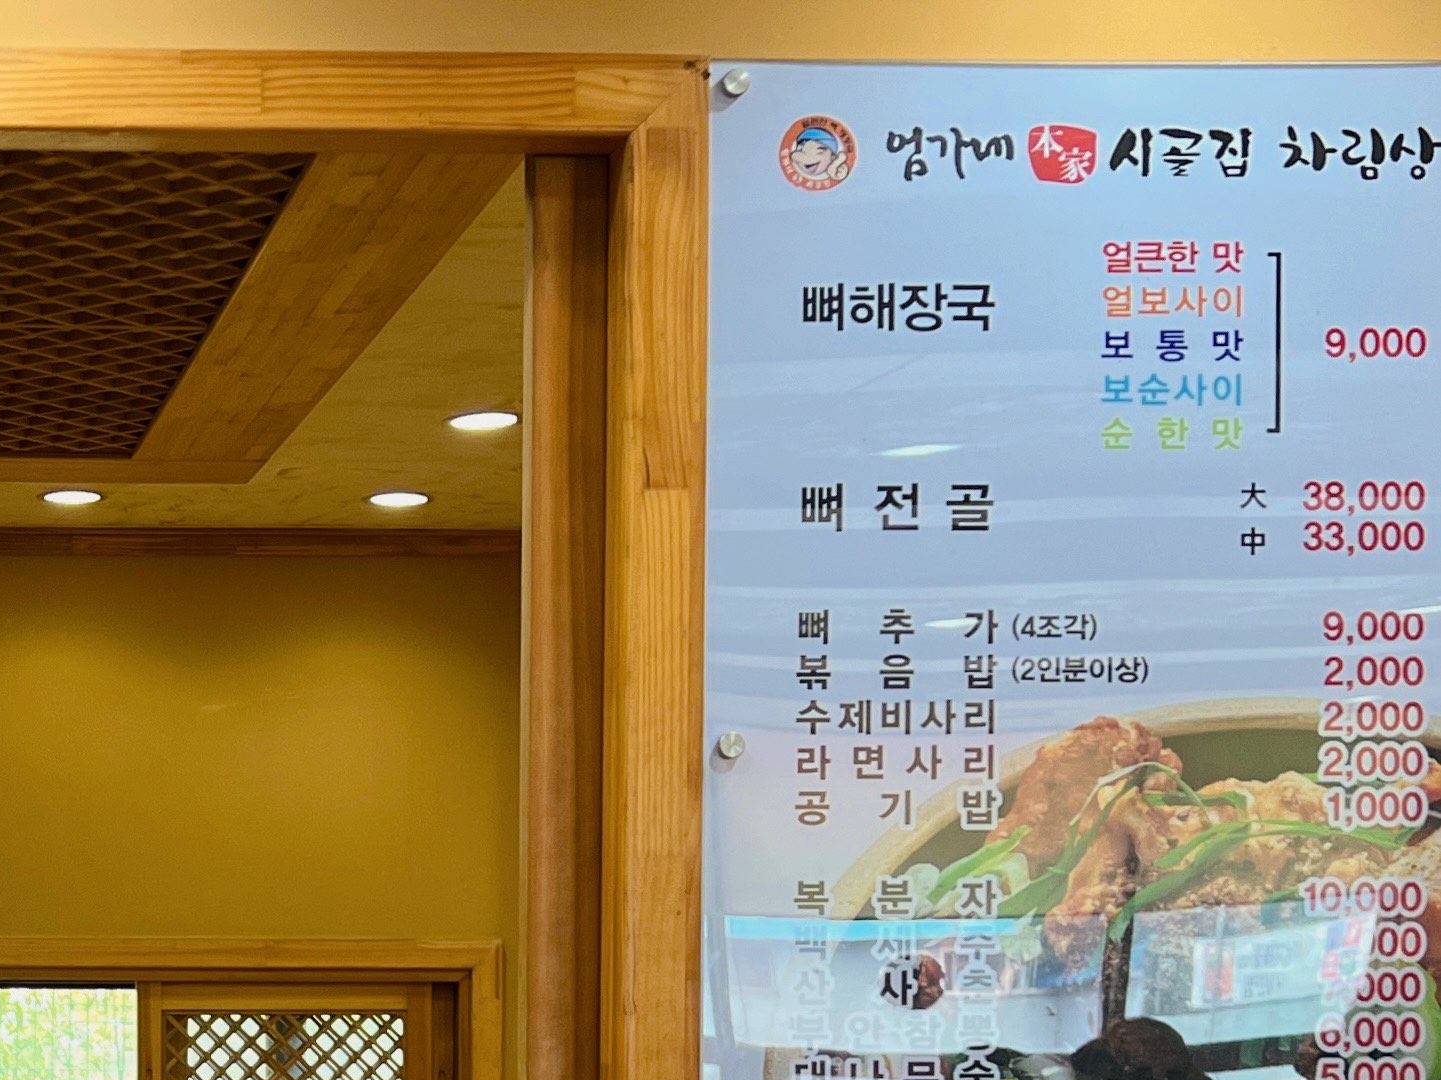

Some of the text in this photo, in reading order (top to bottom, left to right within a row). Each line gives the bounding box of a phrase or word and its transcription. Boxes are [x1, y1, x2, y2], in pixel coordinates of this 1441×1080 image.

[886, 128, 1014, 180] 엄가네
[1029, 125, 1096, 182] 本家
[1109, 128, 1252, 178] 시골집
[1280, 125, 1441, 180] 차림상
[1102, 242, 1244, 273] 얼큰한 맛
[802, 284, 995, 331] 뼈해장국
[1102, 286, 1244, 318] 얼보사이
[1325, 329, 1426, 362] 9,000
[1102, 374, 1243, 406] 보순사이
[1240, 484, 1267, 509] 大
[1303, 482, 1425, 517] 38,000
[1241, 529, 1266, 556] 中
[1303, 523, 1424, 556] 33,000
[1012, 612, 1097, 641] (4조각)
[1323, 611, 1424, 644] 9,000
[1012, 656, 1149, 685] (2인분이상)
[1323, 657, 1424, 690] 2,000
[796, 700, 996, 735] 수제비사리
[1323, 702, 1424, 736] 2,000
[1323, 748, 1424, 780] 2,000
[1329, 792, 1423, 826] 1,000
[1304, 882, 1421, 918] 10,000
[1321, 1016, 1420, 1051] 6,000
